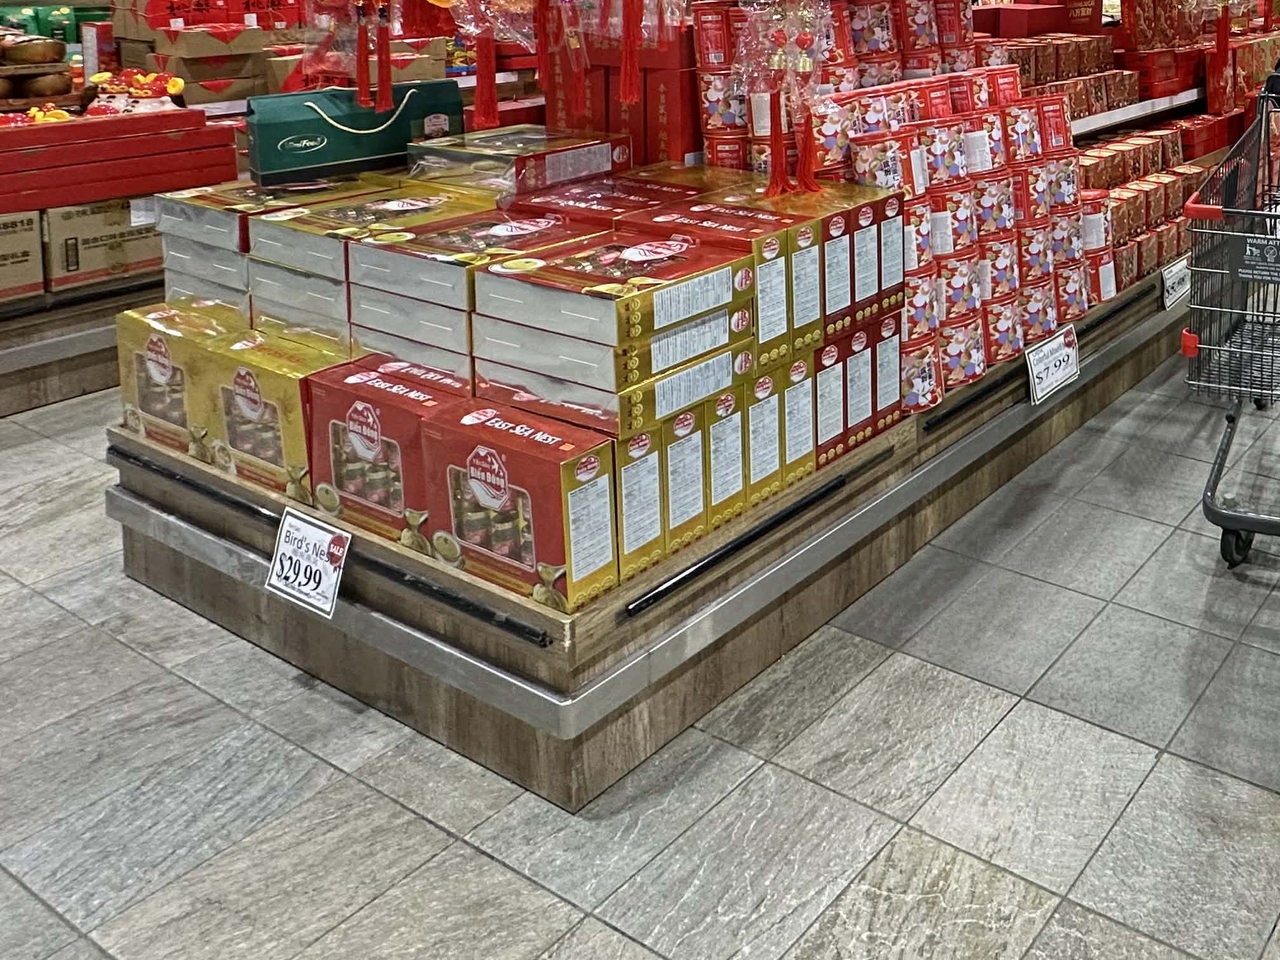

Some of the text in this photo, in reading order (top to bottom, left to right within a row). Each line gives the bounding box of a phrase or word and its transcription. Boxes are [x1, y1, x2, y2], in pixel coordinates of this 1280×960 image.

[1036, 354, 1070, 385] $7.99
[367, 378, 432, 403] EAST SEA NEST
[486, 417, 561, 445] EAST SEA NEST
[284, 530, 311, 553] Bird's
[312, 543, 329, 562] Nes
[330, 544, 344, 557] SALE
[276, 552, 322, 591] $29.99
